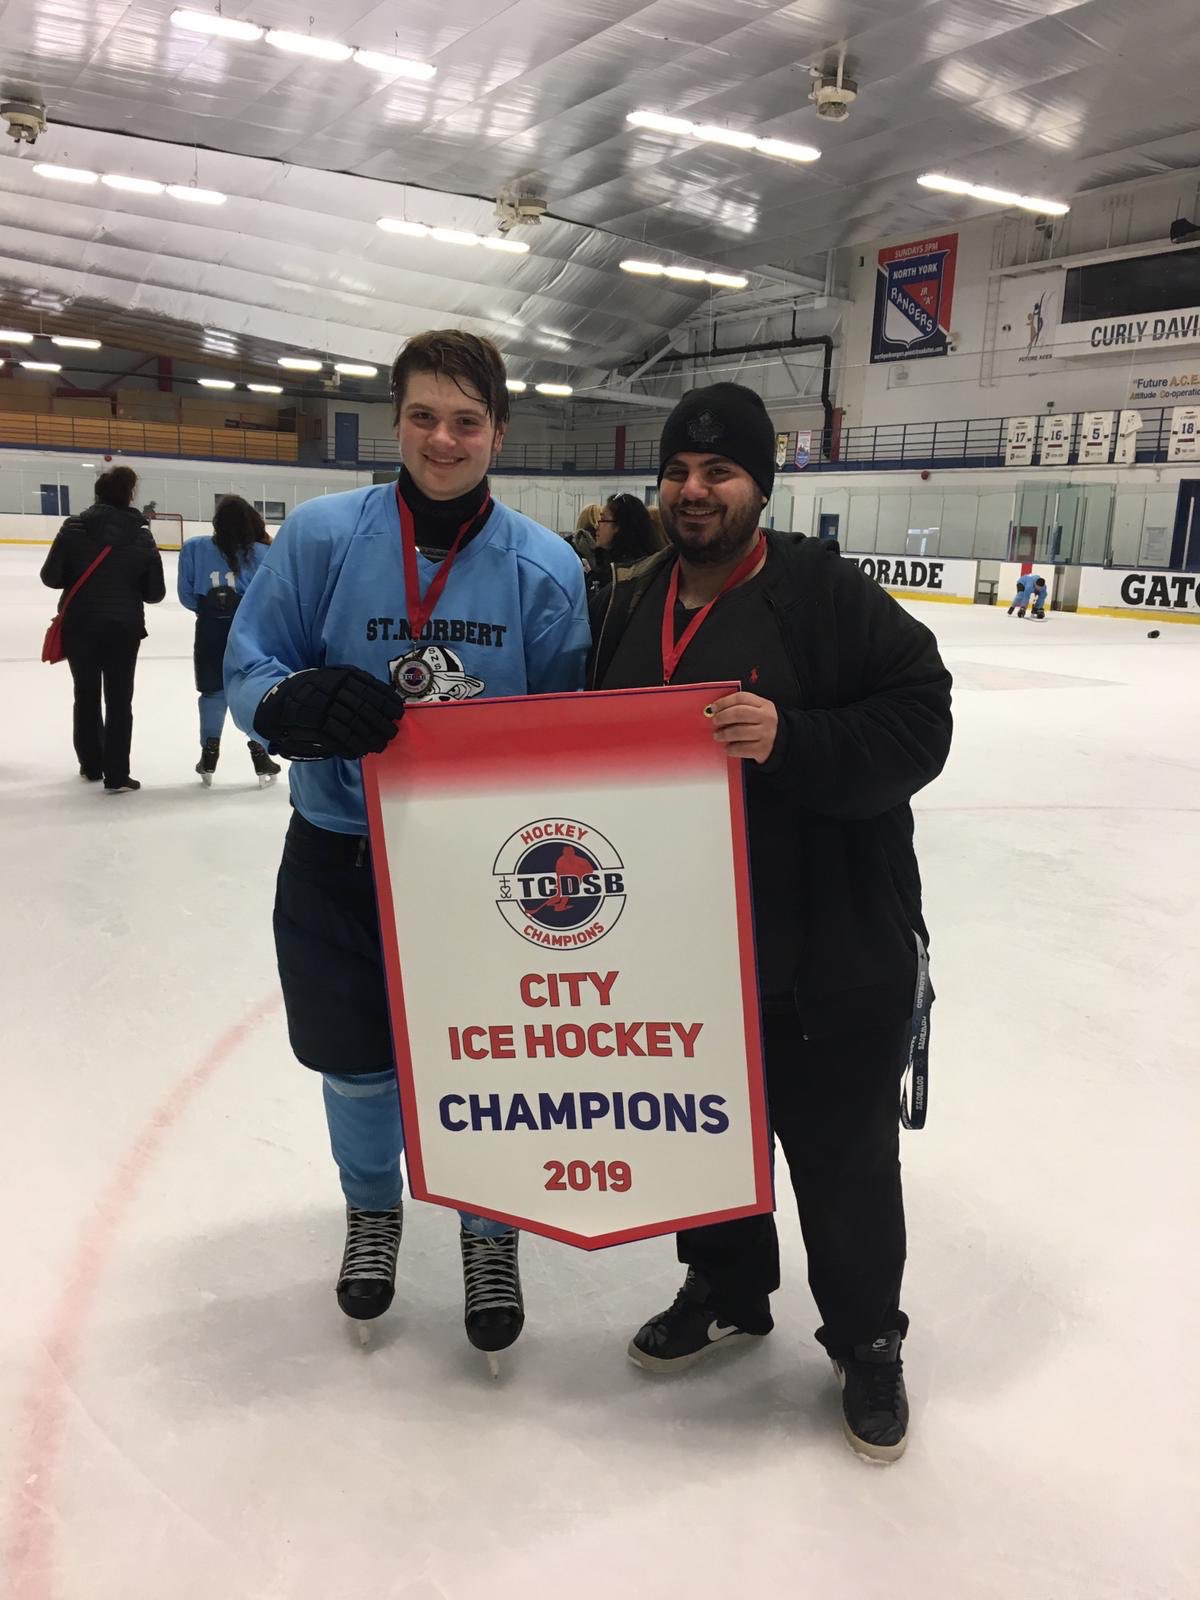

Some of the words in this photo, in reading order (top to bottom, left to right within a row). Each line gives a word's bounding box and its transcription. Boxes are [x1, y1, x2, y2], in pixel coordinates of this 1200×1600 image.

[895, 245, 923, 258] SUNDAYS
[893, 267, 917, 280] NORTH
[918, 262, 938, 275] YORK
[891, 287, 933, 332] RANGERS
[1091, 321, 1148, 348] CURLY
[1015, 432, 1026, 443] 17
[1050, 430, 1062, 441] 16
[1092, 428, 1100, 440] 5
[1182, 423, 1194, 434] 18
[209, 571, 236, 592] 11
[1121, 573, 1200, 608] GAT
[520, 823, 588, 846] HOCKEY
[517, 873, 625, 898] TCDSB
[523, 922, 605, 946] CHAMPIONS
[519, 971, 620, 1008] CITY
[448, 1025, 517, 1060] ICE
[524, 1022, 704, 1058] HOCKEY
[439, 1091, 730, 1134] CHAMPIONS
[543, 1160, 632, 1192] 2019
